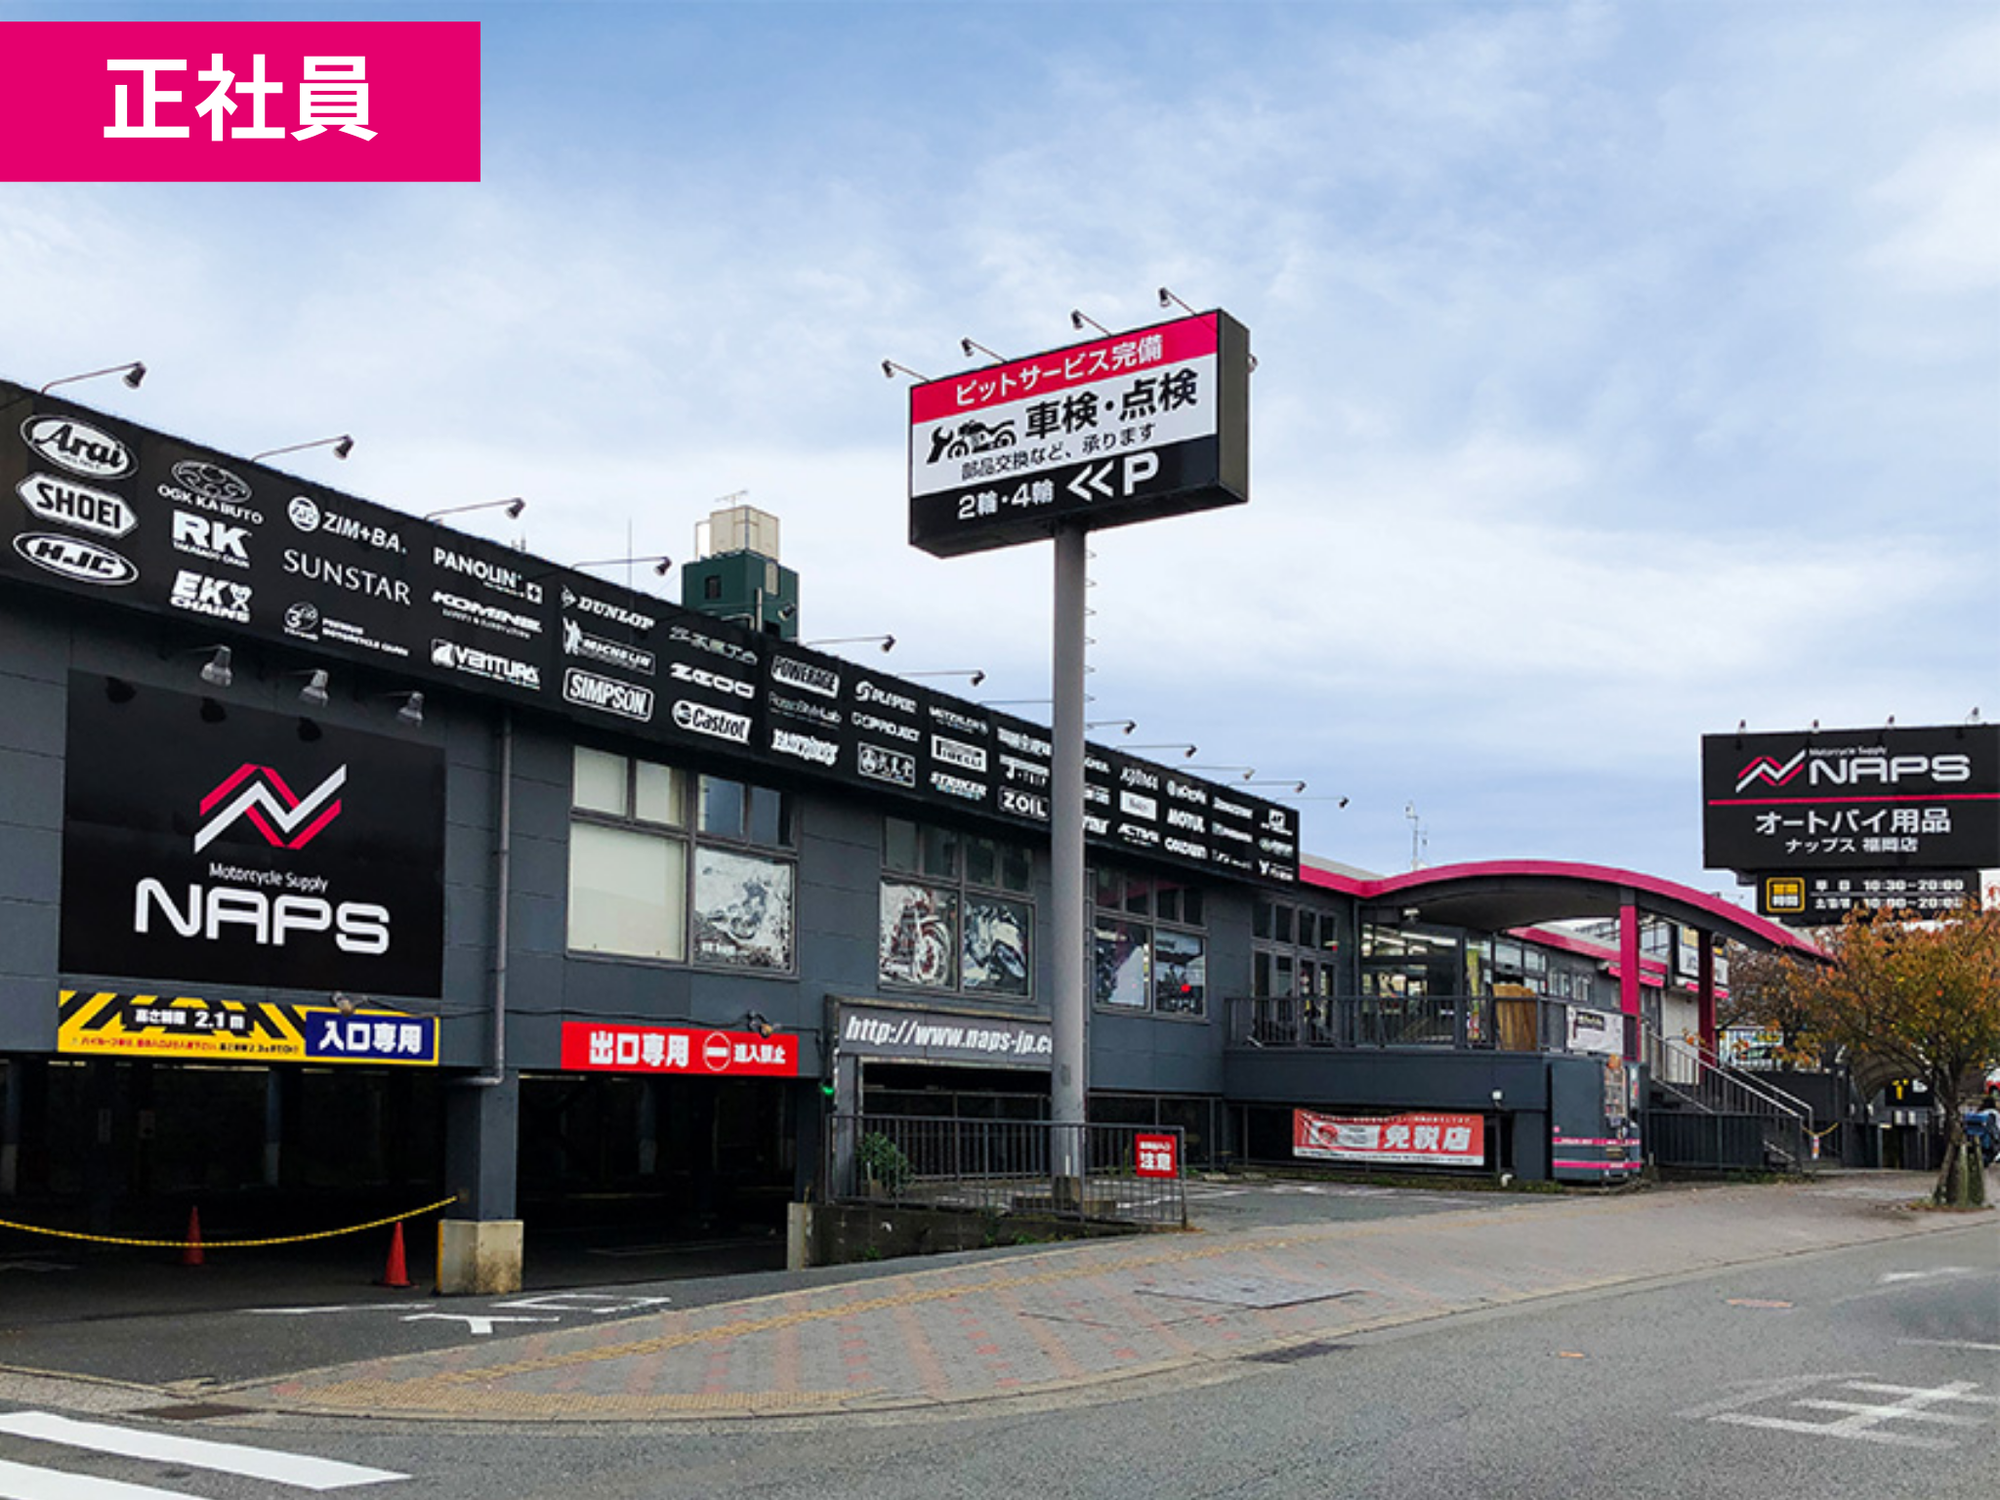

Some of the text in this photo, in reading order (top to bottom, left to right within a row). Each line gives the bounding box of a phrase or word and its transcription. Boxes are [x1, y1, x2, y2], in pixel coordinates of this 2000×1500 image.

[1025, 368, 1197, 440] 車検・点検
[33, 423, 124, 469] Arai
[1123, 452, 1160, 496] P
[36, 482, 121, 530] SHOEI
[157, 484, 193, 505] OGK
[195, 495, 265, 525] KABUTO
[172, 509, 250, 561] RK
[34, 540, 117, 576] HJC
[171, 569, 230, 606] EK
[283, 548, 412, 606] SUNSTAR
[431, 591, 543, 633] KOMINE
[577, 596, 655, 630] DUNLOP
[583, 637, 651, 668] MICHELIN
[569, 673, 647, 717] SIMPSON
[692, 706, 746, 739] Castrol
[1809, 754, 1972, 785] NAPS
[1003, 791, 1047, 818] ZOIL
[1755, 808, 1951, 834] オートバイ用品
[208, 862, 328, 894] Motorcycle Supply
[134, 876, 391, 955] NAPS
[319, 1020, 423, 1054] 入口専用
[589, 1030, 690, 1068] 出口専用
[1383, 1124, 1472, 1152] 免税店
